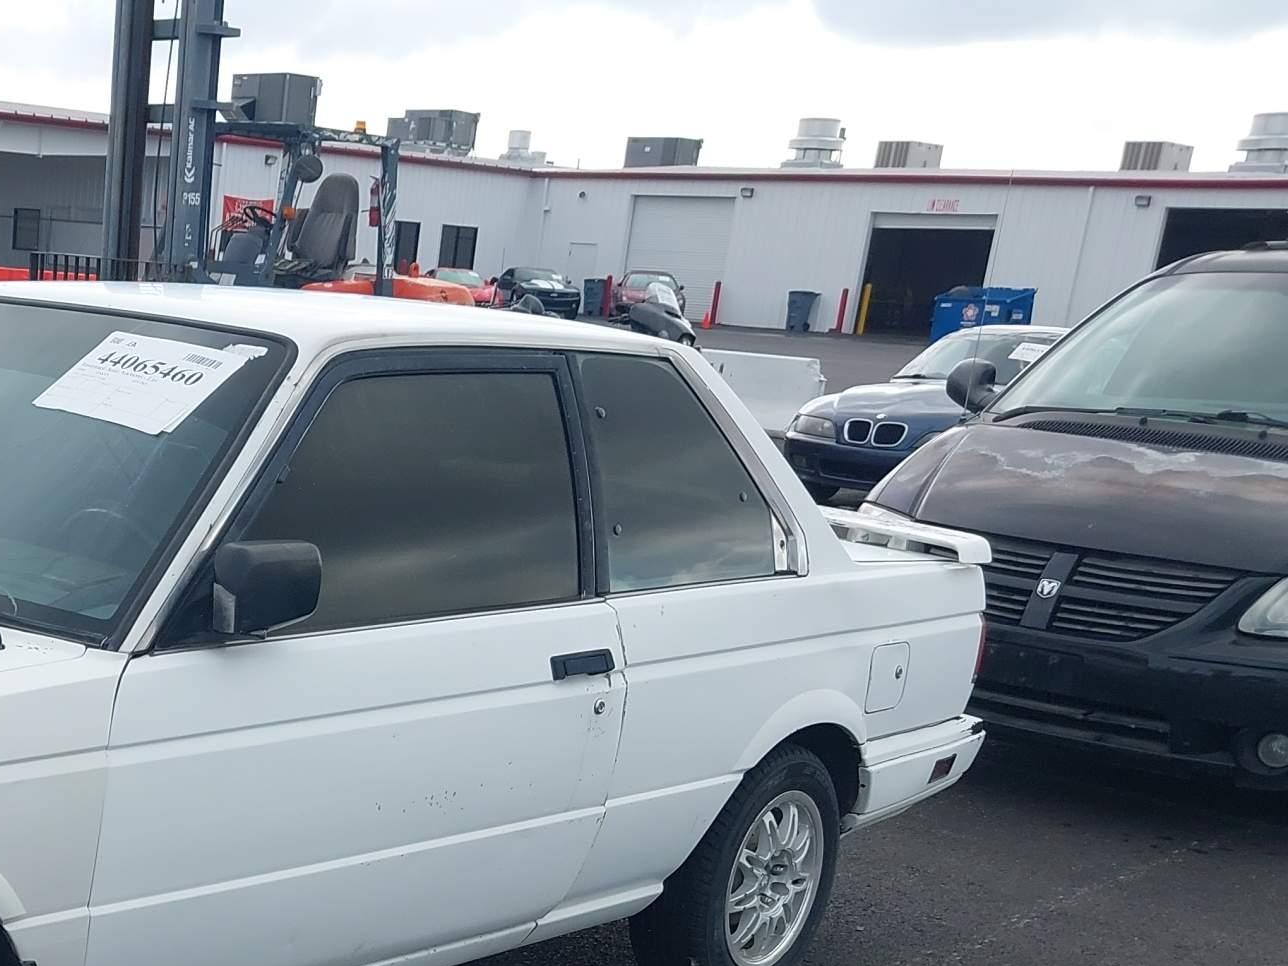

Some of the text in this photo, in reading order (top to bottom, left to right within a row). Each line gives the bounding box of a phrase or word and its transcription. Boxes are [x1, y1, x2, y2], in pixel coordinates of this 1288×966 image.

[185, 117, 196, 168] Kalmar AC
[97, 351, 204, 386] 44065460
